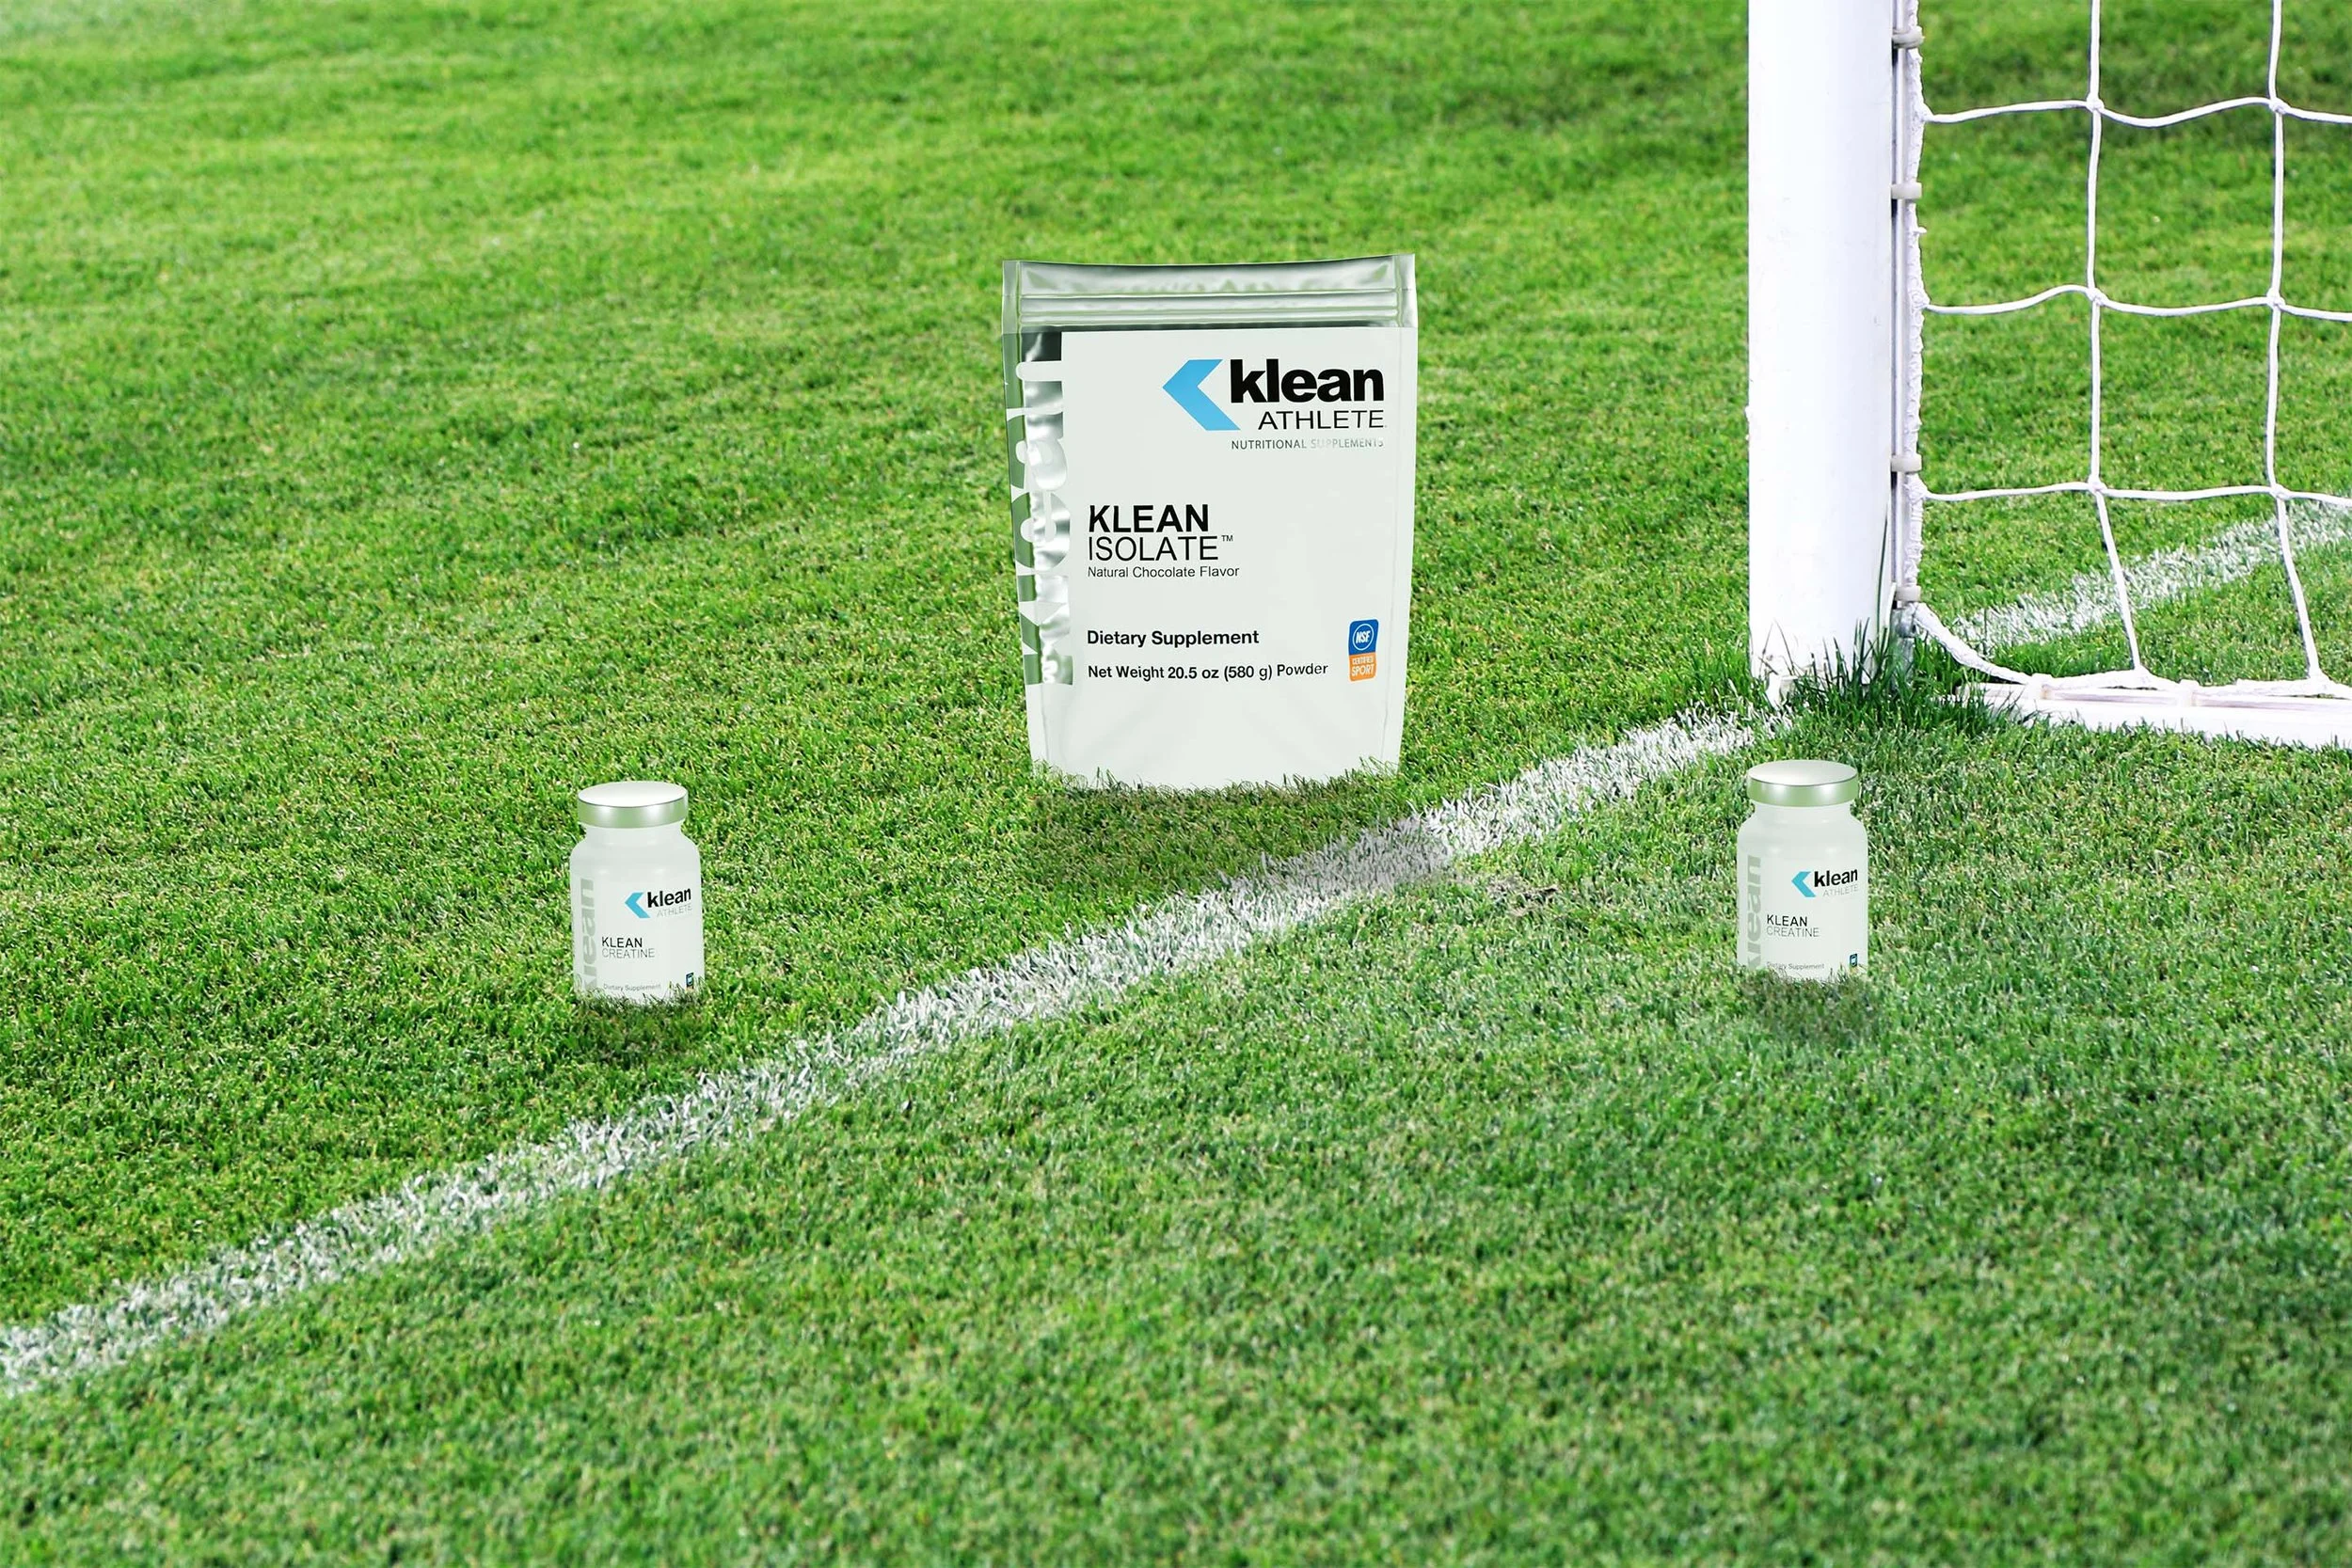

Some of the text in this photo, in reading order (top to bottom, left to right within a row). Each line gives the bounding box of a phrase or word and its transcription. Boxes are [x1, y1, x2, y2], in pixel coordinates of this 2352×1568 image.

[1230, 358, 1384, 404] klean
[1258, 410, 1385, 430] ATHLETE
[1231, 437, 1384, 450] NUTRITIONAL SUPPLEMENTS
[1089, 504, 1209, 532] KLEAN
[1088, 565, 1240, 578] Natural Chocolate Flavor
[1088, 630, 1259, 648] Dietary Supplement
[1355, 629, 1371, 643] NSF
[1088, 663, 1328, 682] Net Weight 20.5 oz (580 g) Powder
[1351, 663, 1375, 676] SPORT
[1814, 869, 1858, 887] klean
[1822, 884, 1859, 897] ATHLETE
[647, 888, 691, 908] klean
[657, 904, 693, 918] ATHLETE
[1767, 914, 1807, 927] KLEAN
[1766, 927, 1820, 937] CREATINE
[602, 937, 643, 948] KLEAN
[602, 948, 656, 958] CREATINE
